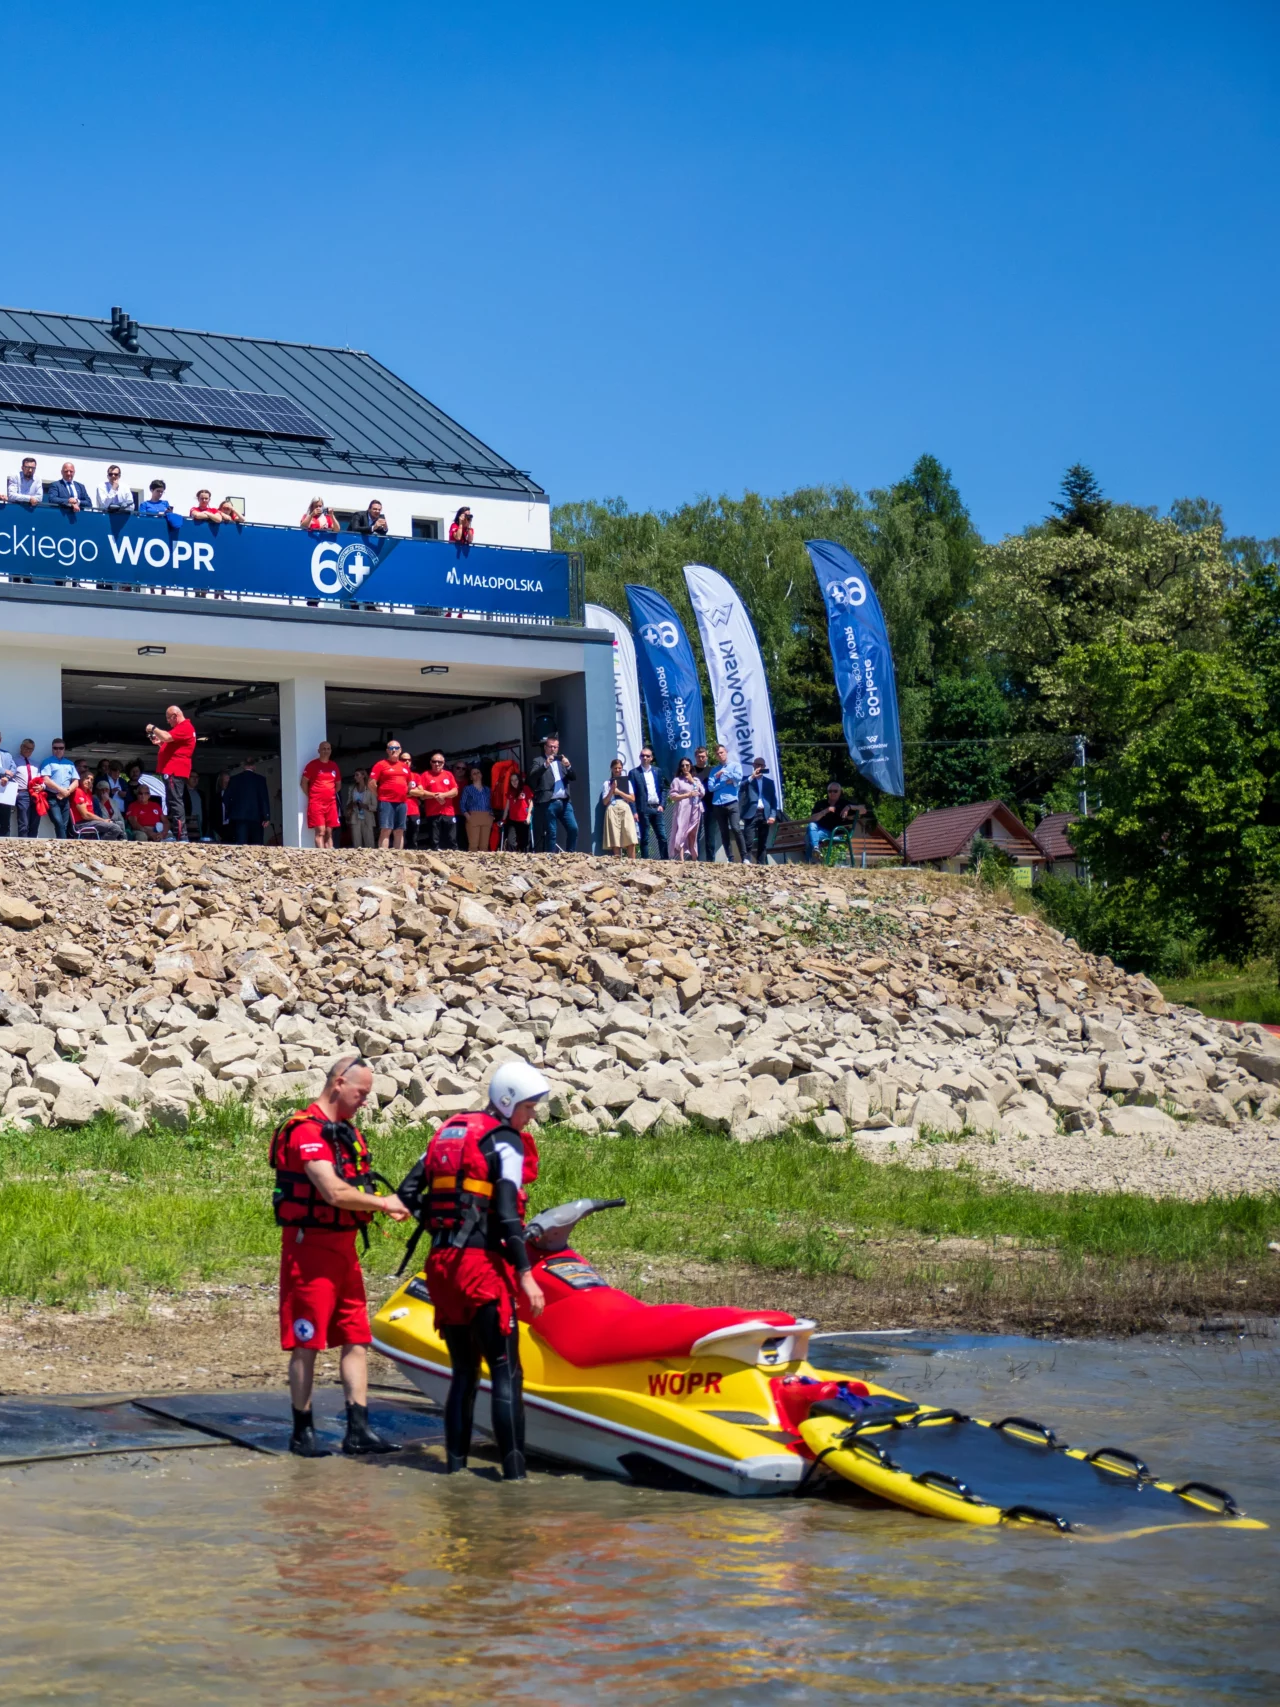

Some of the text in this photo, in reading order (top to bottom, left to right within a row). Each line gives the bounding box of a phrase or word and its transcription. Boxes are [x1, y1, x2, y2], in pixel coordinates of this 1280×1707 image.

[107, 533, 215, 572] WOPR
[463, 573, 543, 592] MAŁOPOLSKA
[647, 1371, 723, 1396] WOPR
